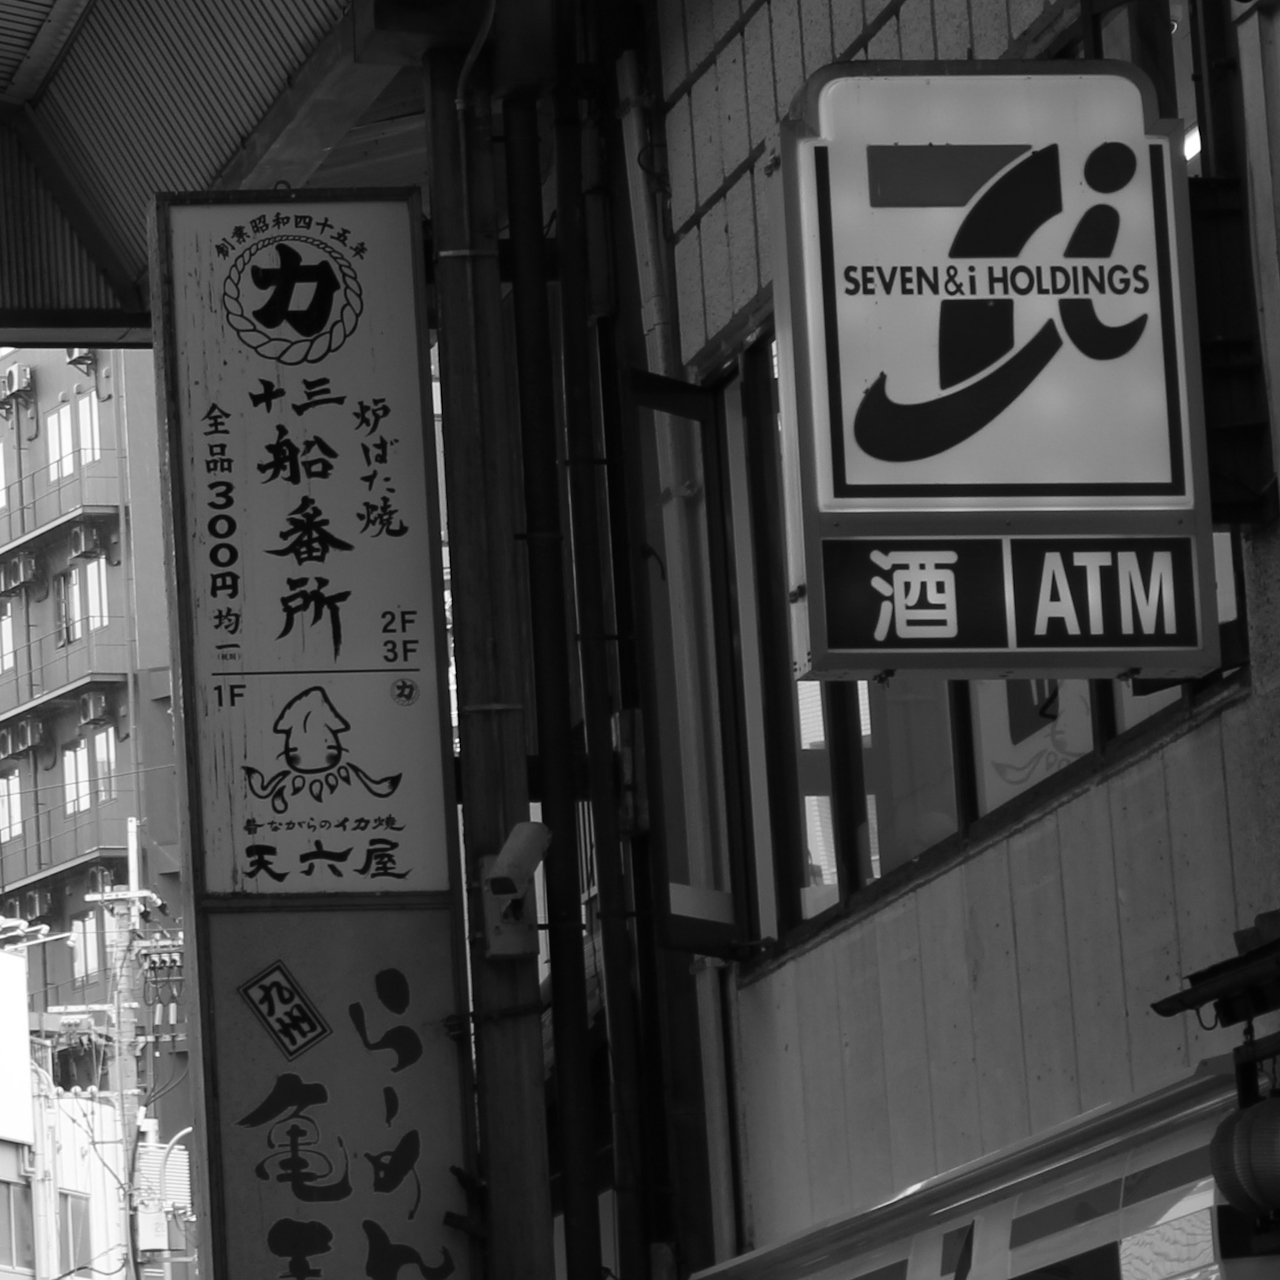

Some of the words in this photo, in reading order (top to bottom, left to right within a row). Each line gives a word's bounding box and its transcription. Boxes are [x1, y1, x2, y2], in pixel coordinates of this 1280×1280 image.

[988, 264, 1150, 295] HOLDINGS
[869, 549, 959, 642] 酒
[1034, 551, 1178, 637] ATM
[381, 611, 418, 633] 2F
[383, 640, 419, 663] 3F
[214, 684, 247, 707] 1F
[243, 838, 414, 883] 天六屋
[258, 981, 318, 1047] 九州
[348, 968, 456, 1280] らーめん
